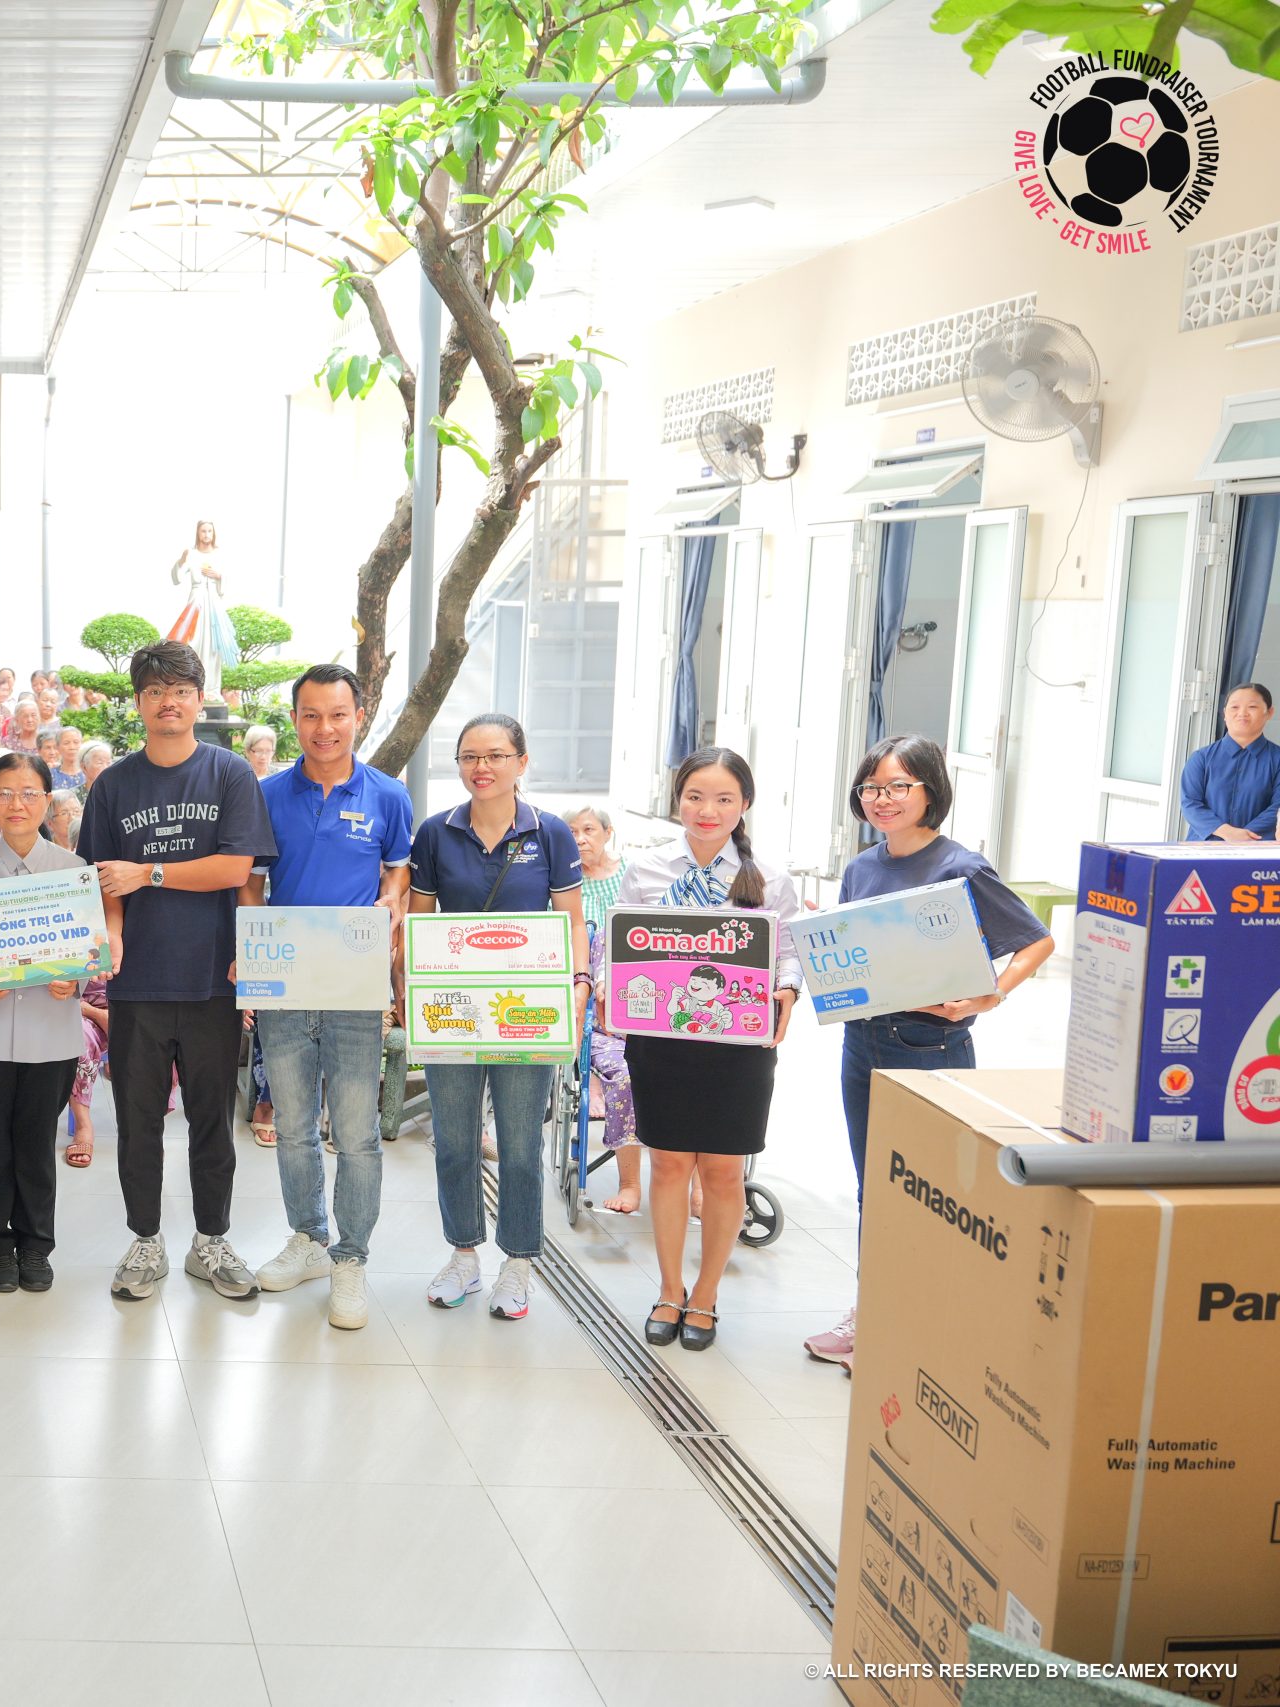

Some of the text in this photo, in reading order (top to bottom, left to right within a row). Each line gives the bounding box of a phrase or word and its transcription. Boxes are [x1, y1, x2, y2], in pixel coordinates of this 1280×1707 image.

[121, 803, 219, 834] BINH DUONG
[143, 838, 195, 855] NEW CITY
[1087, 890, 1138, 917] SENKO
[29, 915, 50, 927] TRỊ
[52, 909, 74, 923] GIÁ
[925, 912, 950, 928] TH
[1165, 916, 1188, 926] TÂN
[61, 926, 90, 940] VNĐ
[245, 921, 273, 937] TH
[352, 929, 370, 940] TH
[464, 923, 485, 933] Cook
[626, 926, 737, 954] Omachi
[803, 929, 837, 949] TH
[243, 938, 296, 960] true
[244, 961, 296, 974] YOGURT
[808, 946, 868, 973] true
[814, 964, 872, 988] YOGURT
[641, 986, 665, 1001] Sáng
[890, 1149, 1008, 1261] Panasonic
[1004, 1382, 1041, 1422] Automatic
[920, 1382, 973, 1445] FRONT
[984, 1384, 1051, 1450] Washing Machine
[1147, 1438, 1218, 1451] Automatic
[1107, 1458, 1236, 1473] Wasing Machine
